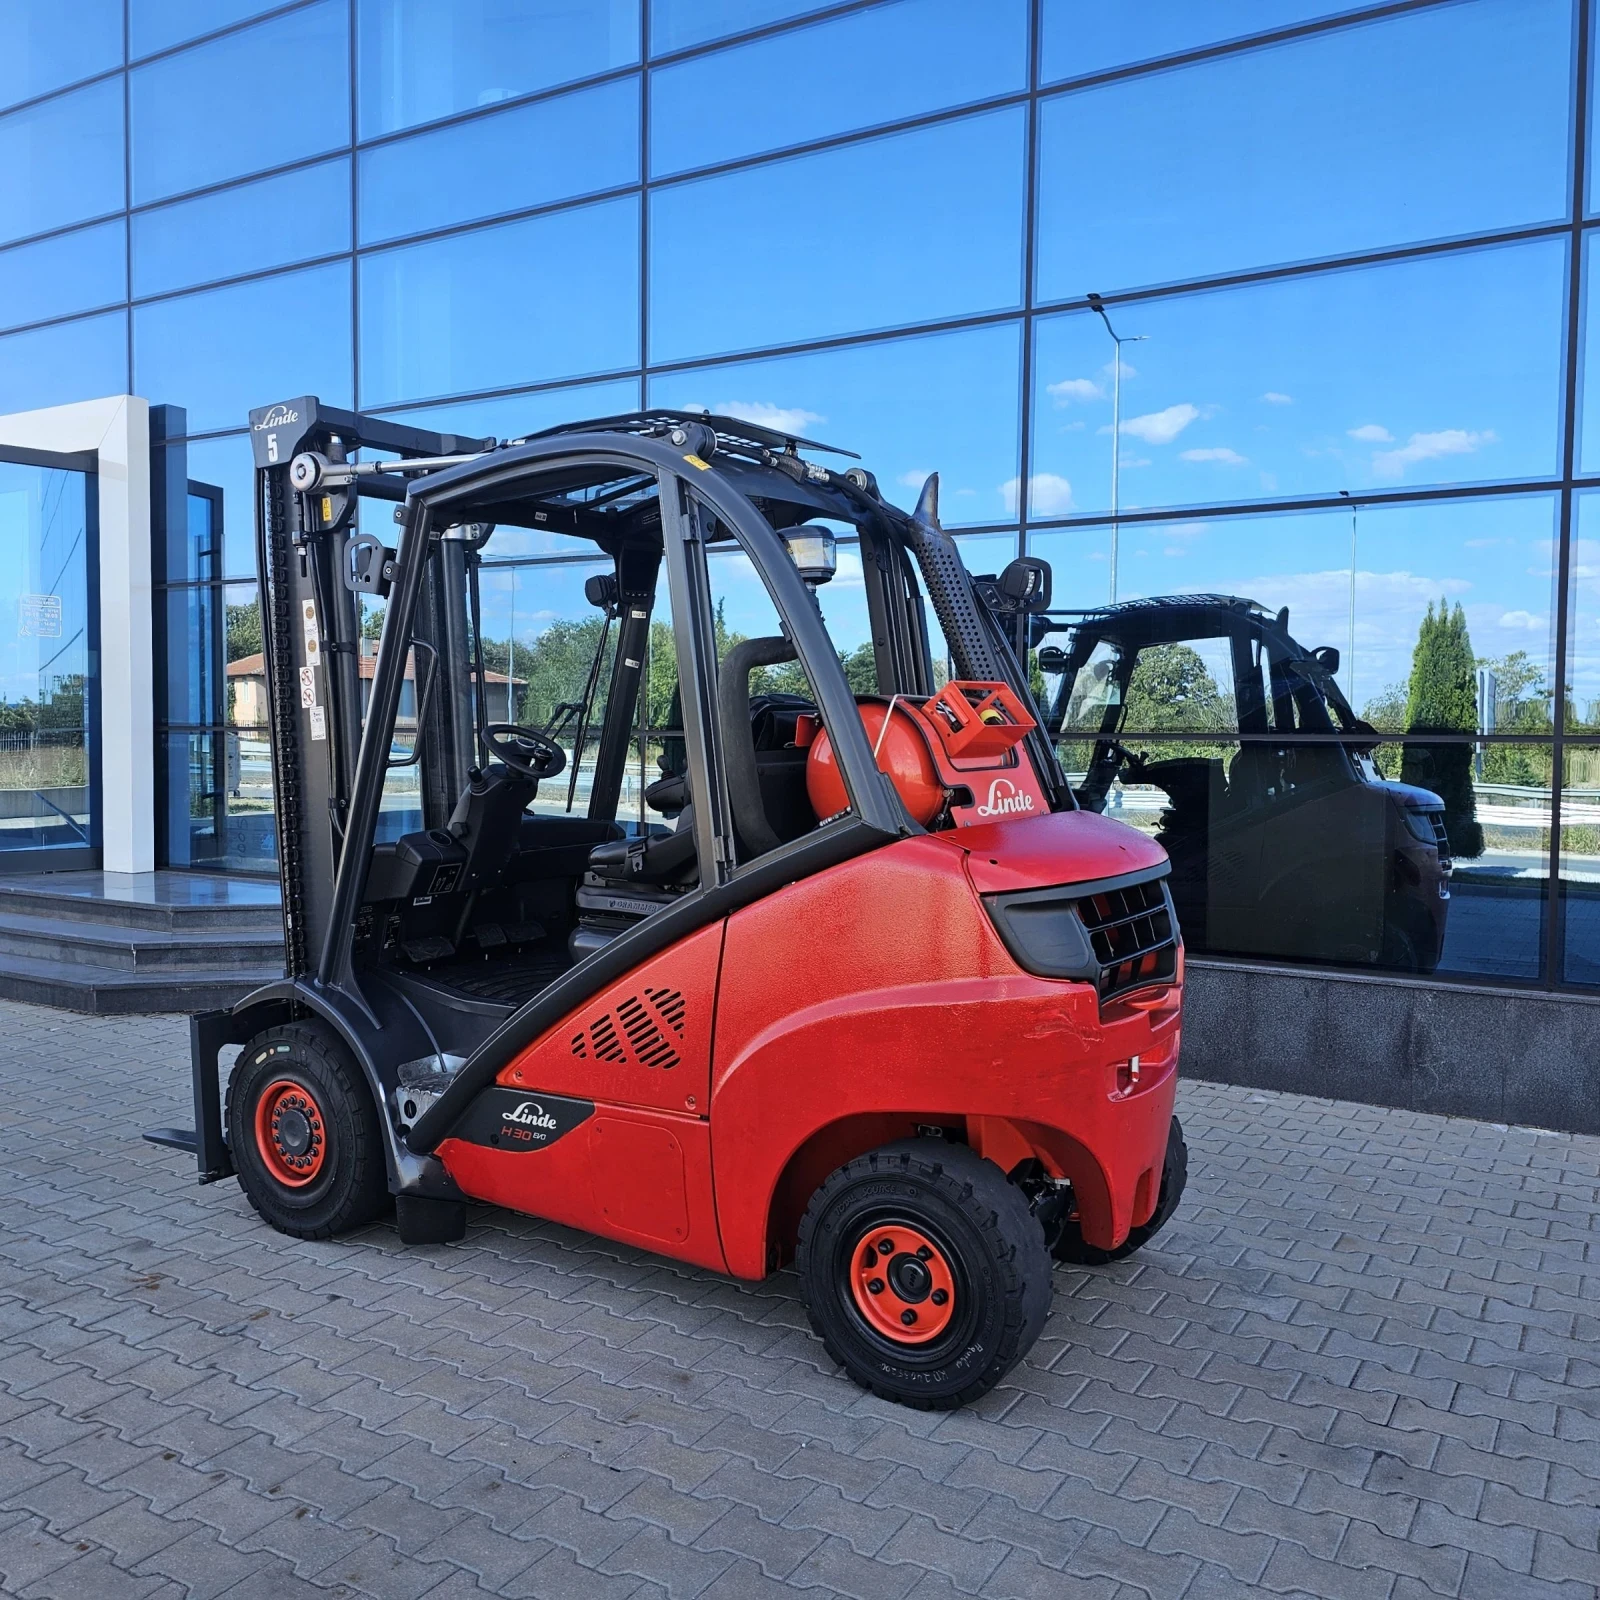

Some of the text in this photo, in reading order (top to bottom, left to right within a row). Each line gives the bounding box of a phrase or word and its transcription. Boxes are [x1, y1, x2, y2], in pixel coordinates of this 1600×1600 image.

[254, 405, 299, 431] Linde
[267, 433, 279, 463] 5
[977, 778, 1035, 817] Linde
[502, 1101, 557, 1129] Linde
[862, 1184, 897, 1197] SOURCE
